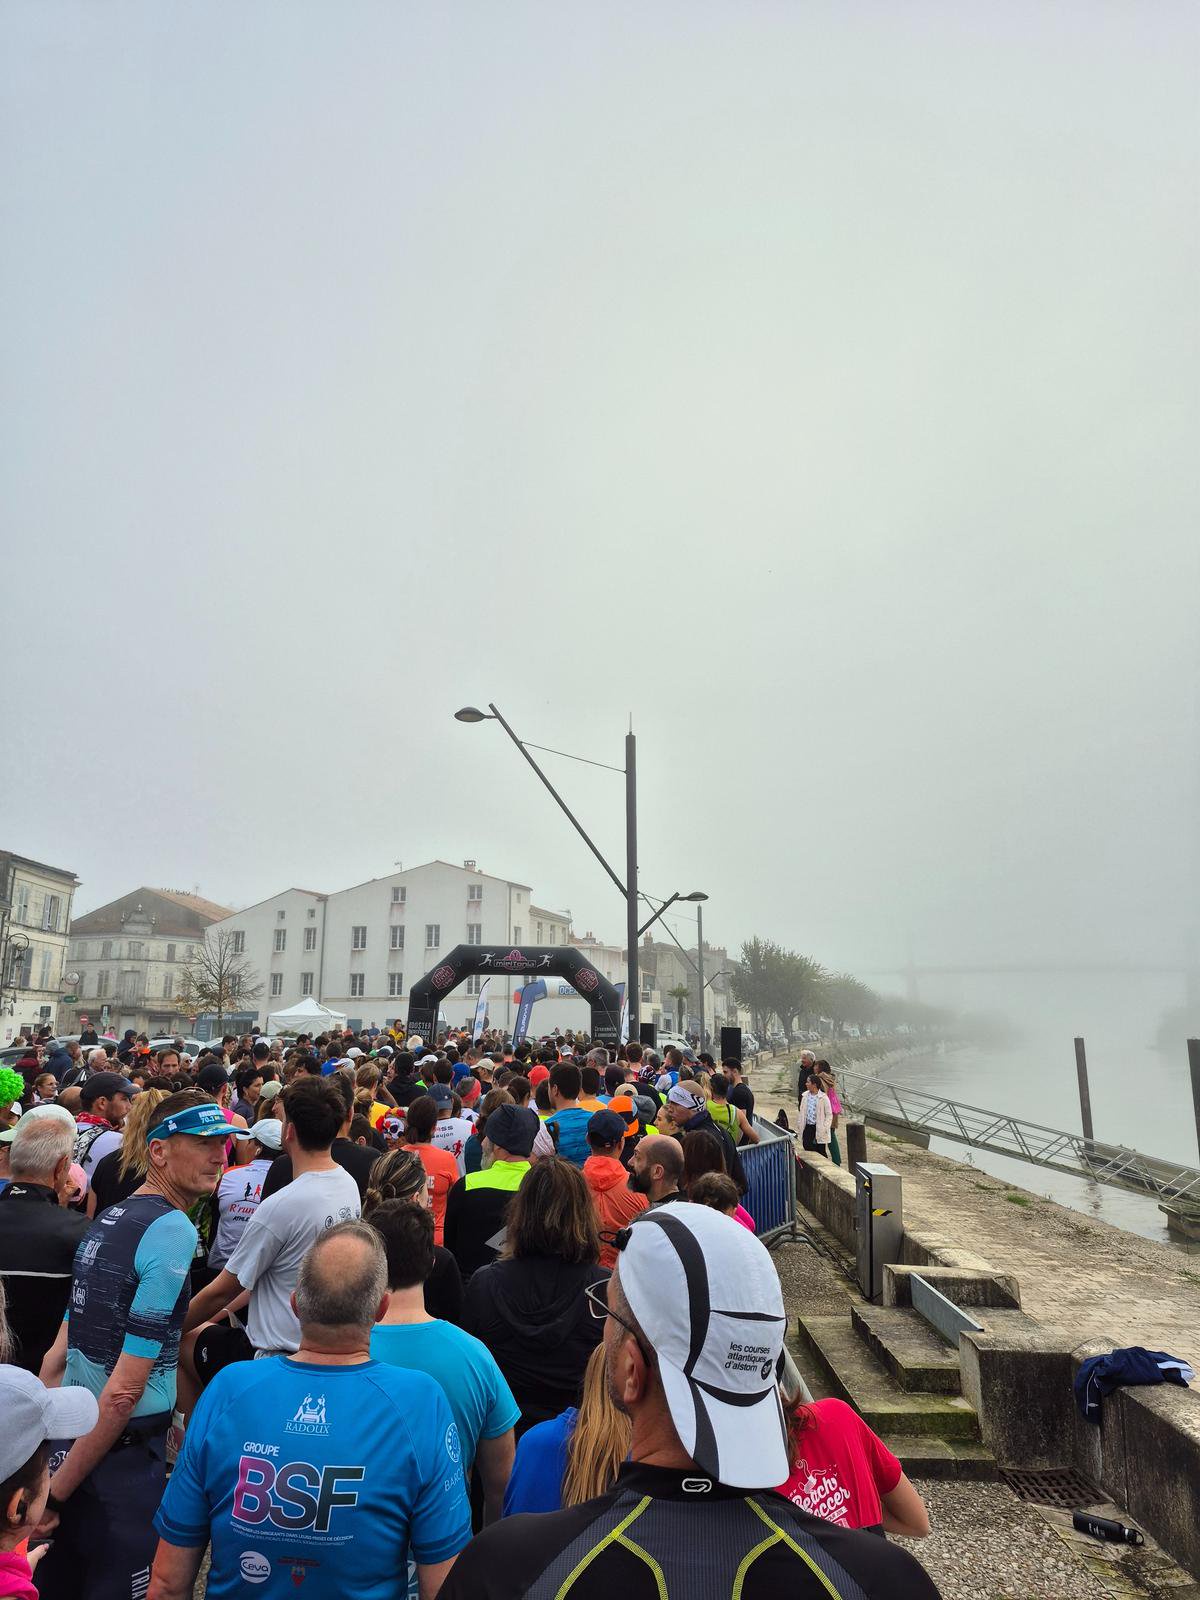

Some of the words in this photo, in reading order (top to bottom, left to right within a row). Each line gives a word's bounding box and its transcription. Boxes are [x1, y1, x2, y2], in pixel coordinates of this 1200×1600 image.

[730, 1341, 743, 1352] les
[744, 1345, 771, 1354] courses
[727, 1352, 767, 1364] atlantiques
[724, 1361, 758, 1372] d'alstom
[285, 1421, 330, 1434] RADOUX
[243, 1441, 280, 1457] GROUPE
[231, 1455, 366, 1533] BSF
[806, 1486, 851, 1518] occer
[242, 1561, 269, 1572] Ceva
